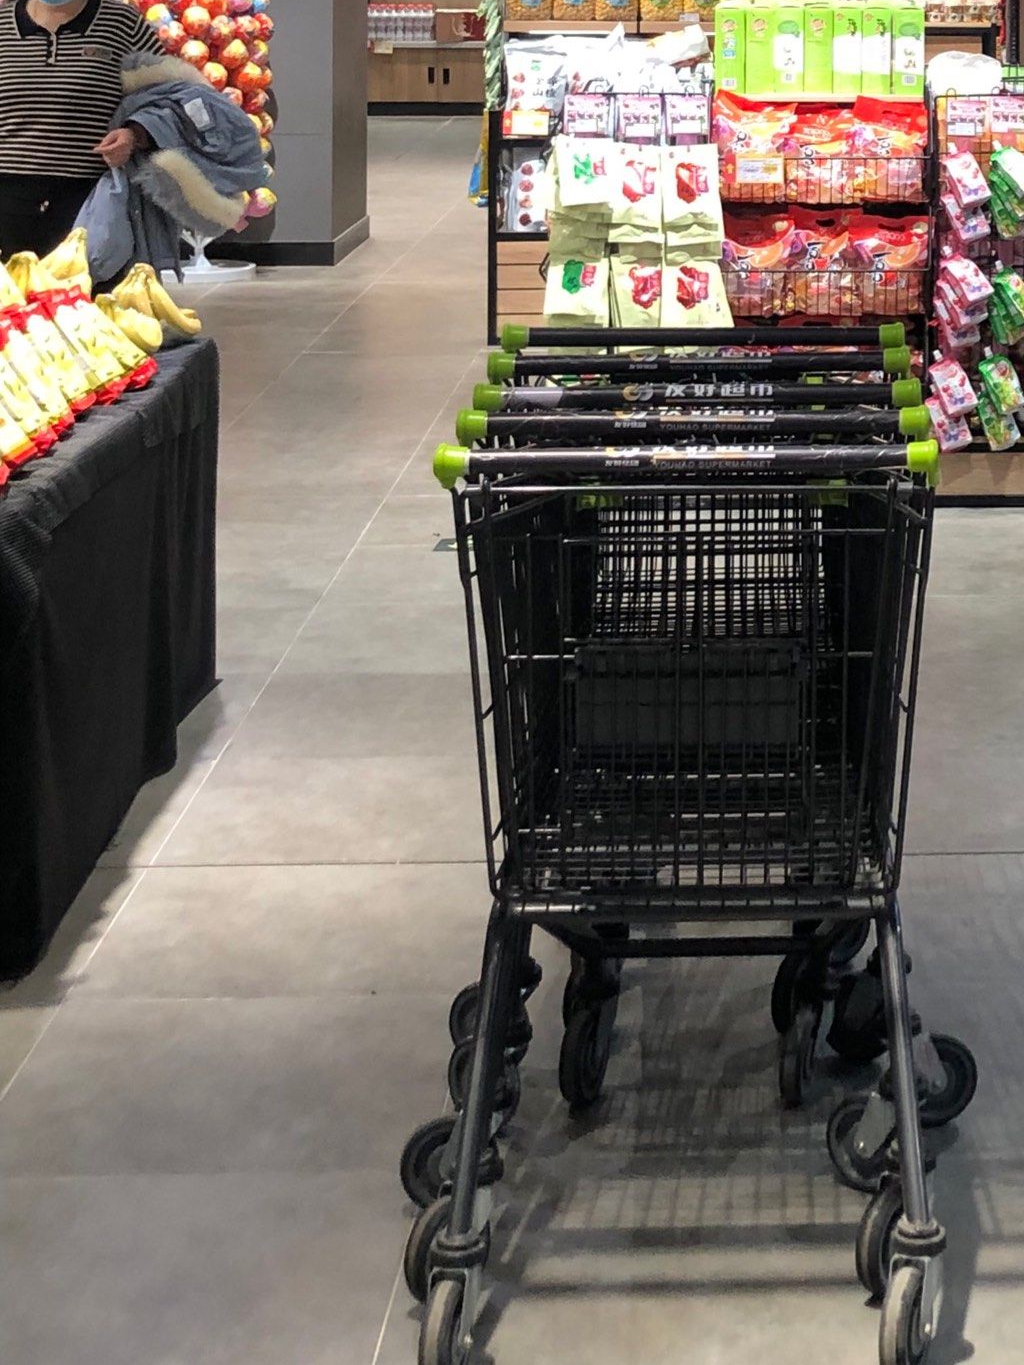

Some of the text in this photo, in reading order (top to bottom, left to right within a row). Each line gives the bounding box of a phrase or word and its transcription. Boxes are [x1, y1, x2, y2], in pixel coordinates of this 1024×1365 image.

[664, 383, 774, 397] 友好超市
[660, 423, 771, 431] YOUHAO SUPERMARKET
[655, 460, 772, 469] YOUHAO SUPERMARKET
